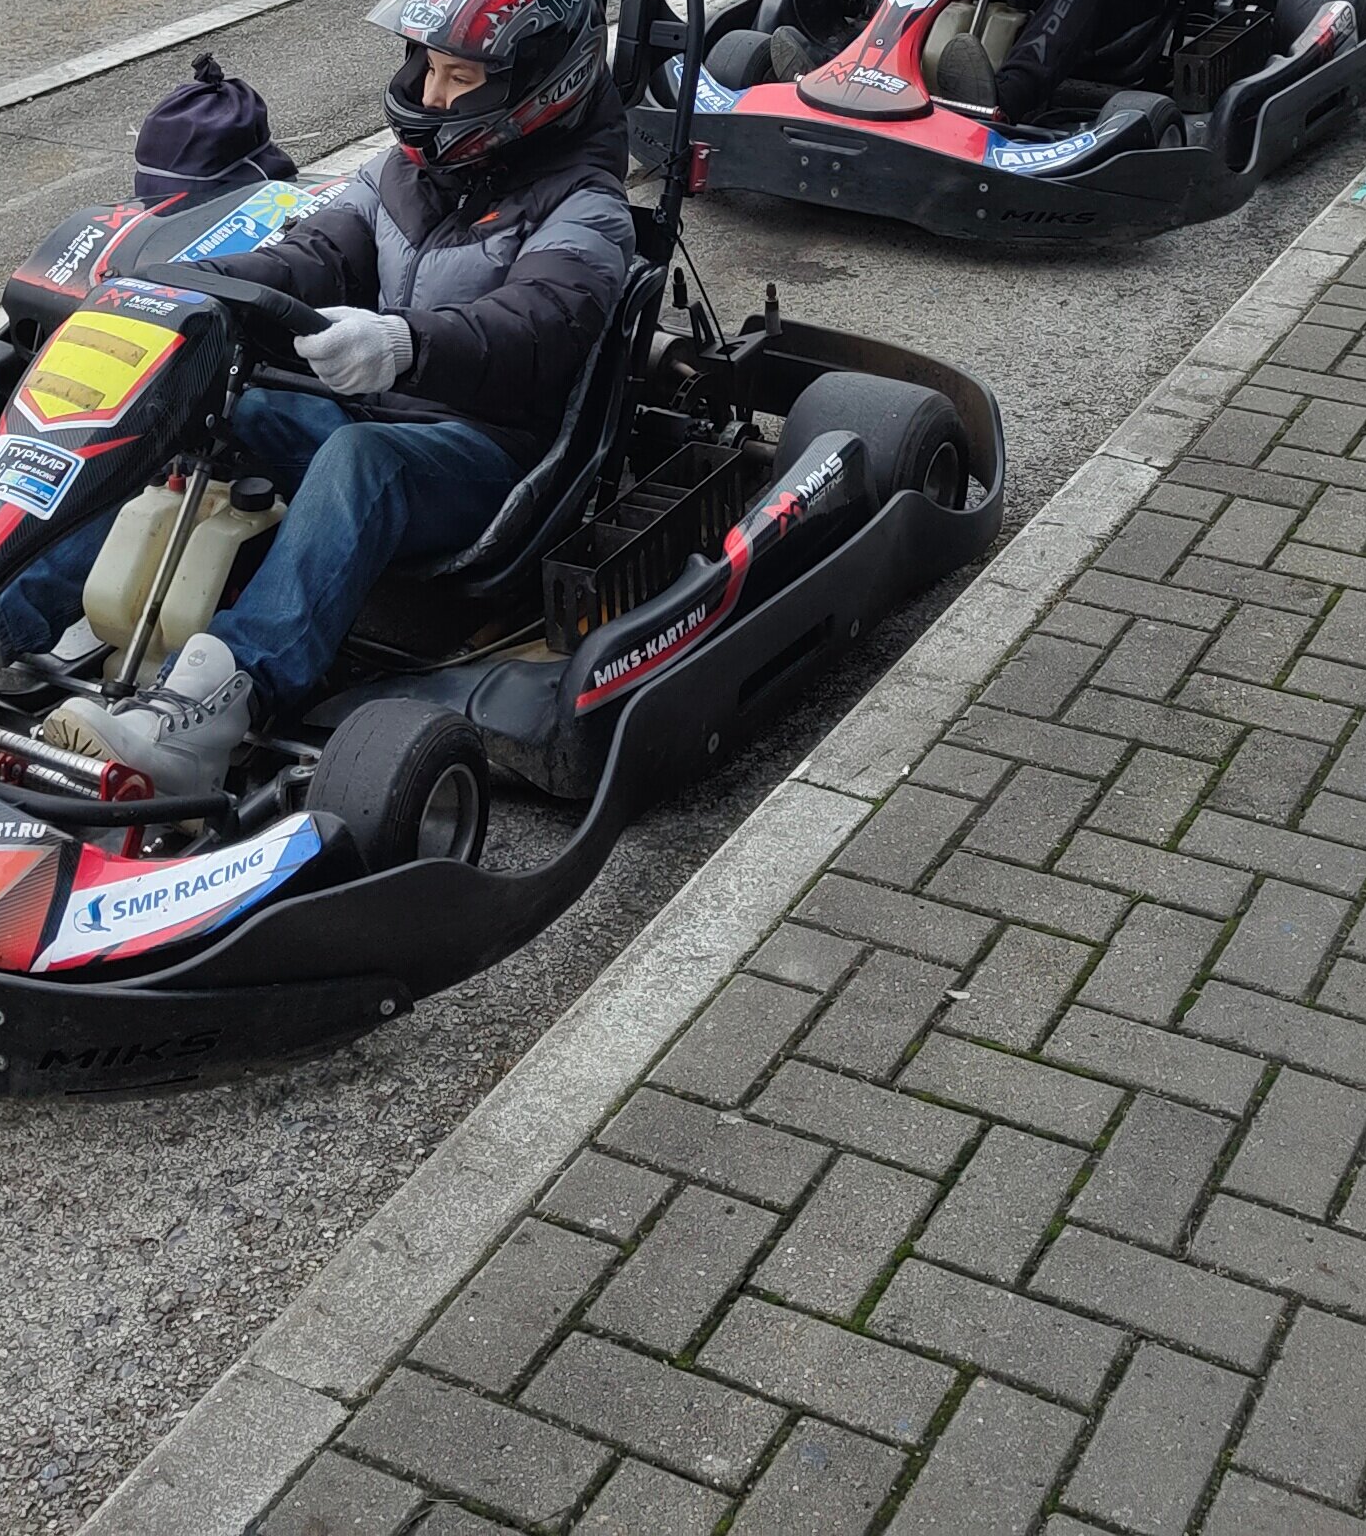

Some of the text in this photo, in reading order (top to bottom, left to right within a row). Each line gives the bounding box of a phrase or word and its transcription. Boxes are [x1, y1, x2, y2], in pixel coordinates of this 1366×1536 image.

[849, 74, 901, 96] KARTING
[853, 67, 912, 90] MIKS
[1000, 135, 1092, 166] AIMOL
[1001, 209, 1097, 225] MIKS
[45, 224, 92, 280] KARTING
[58, 228, 105, 286] MIKS
[123, 302, 170, 317] KARTING
[129, 295, 179, 312] MIKS
[7, 445, 67, 472] ТУРНИР
[796, 451, 844, 499] MIKS
[593, 603, 707, 689] MIKS-KART.RU
[112, 848, 265, 921] SMP RACING
[37, 1029, 225, 1071] MIKS
